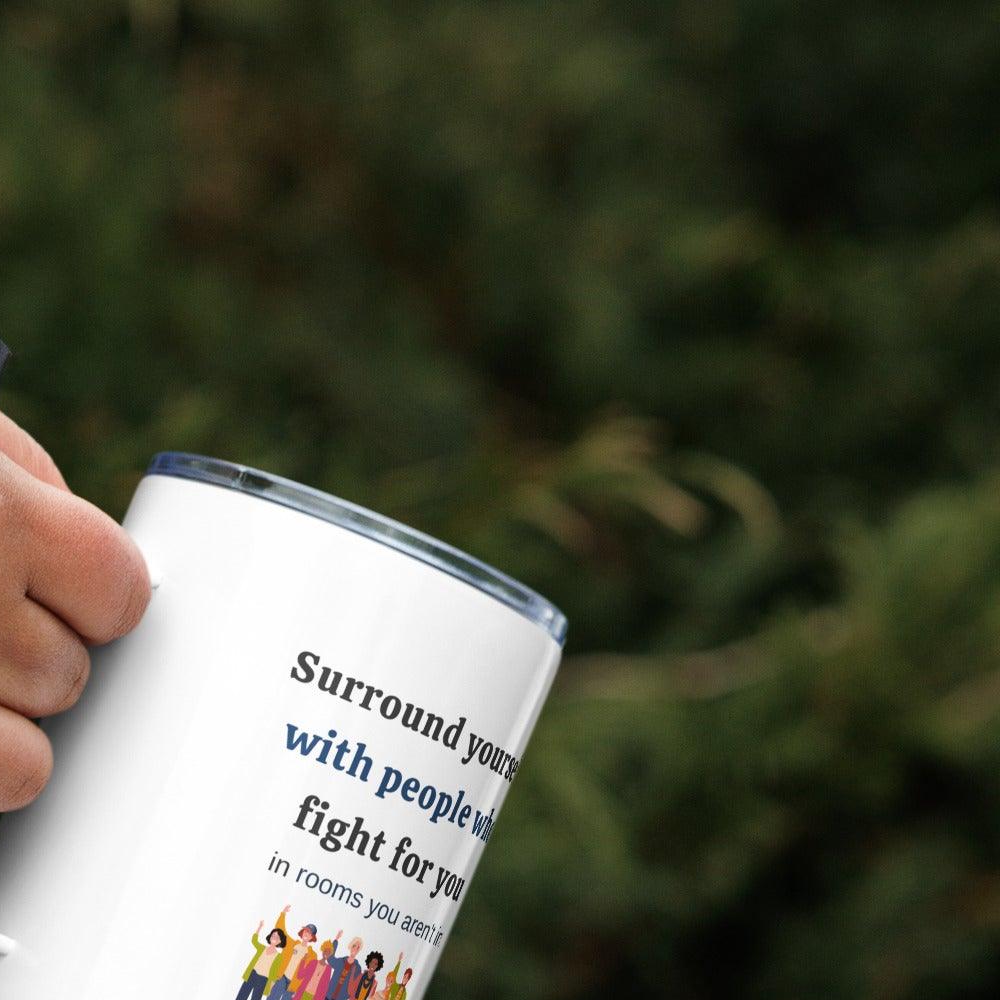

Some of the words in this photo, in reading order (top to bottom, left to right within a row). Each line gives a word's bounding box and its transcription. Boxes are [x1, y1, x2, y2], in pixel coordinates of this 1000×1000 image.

[290, 651, 467, 750] Surround
[285, 723, 374, 782] with
[375, 766, 472, 828] people
[267, 851, 291, 878] in
[295, 867, 364, 908] rooms
[364, 898, 400, 926] you
[400, 914, 436, 943] aren't
[292, 795, 387, 862] fight
[388, 836, 434, 884] for
[429, 866, 465, 901] you
